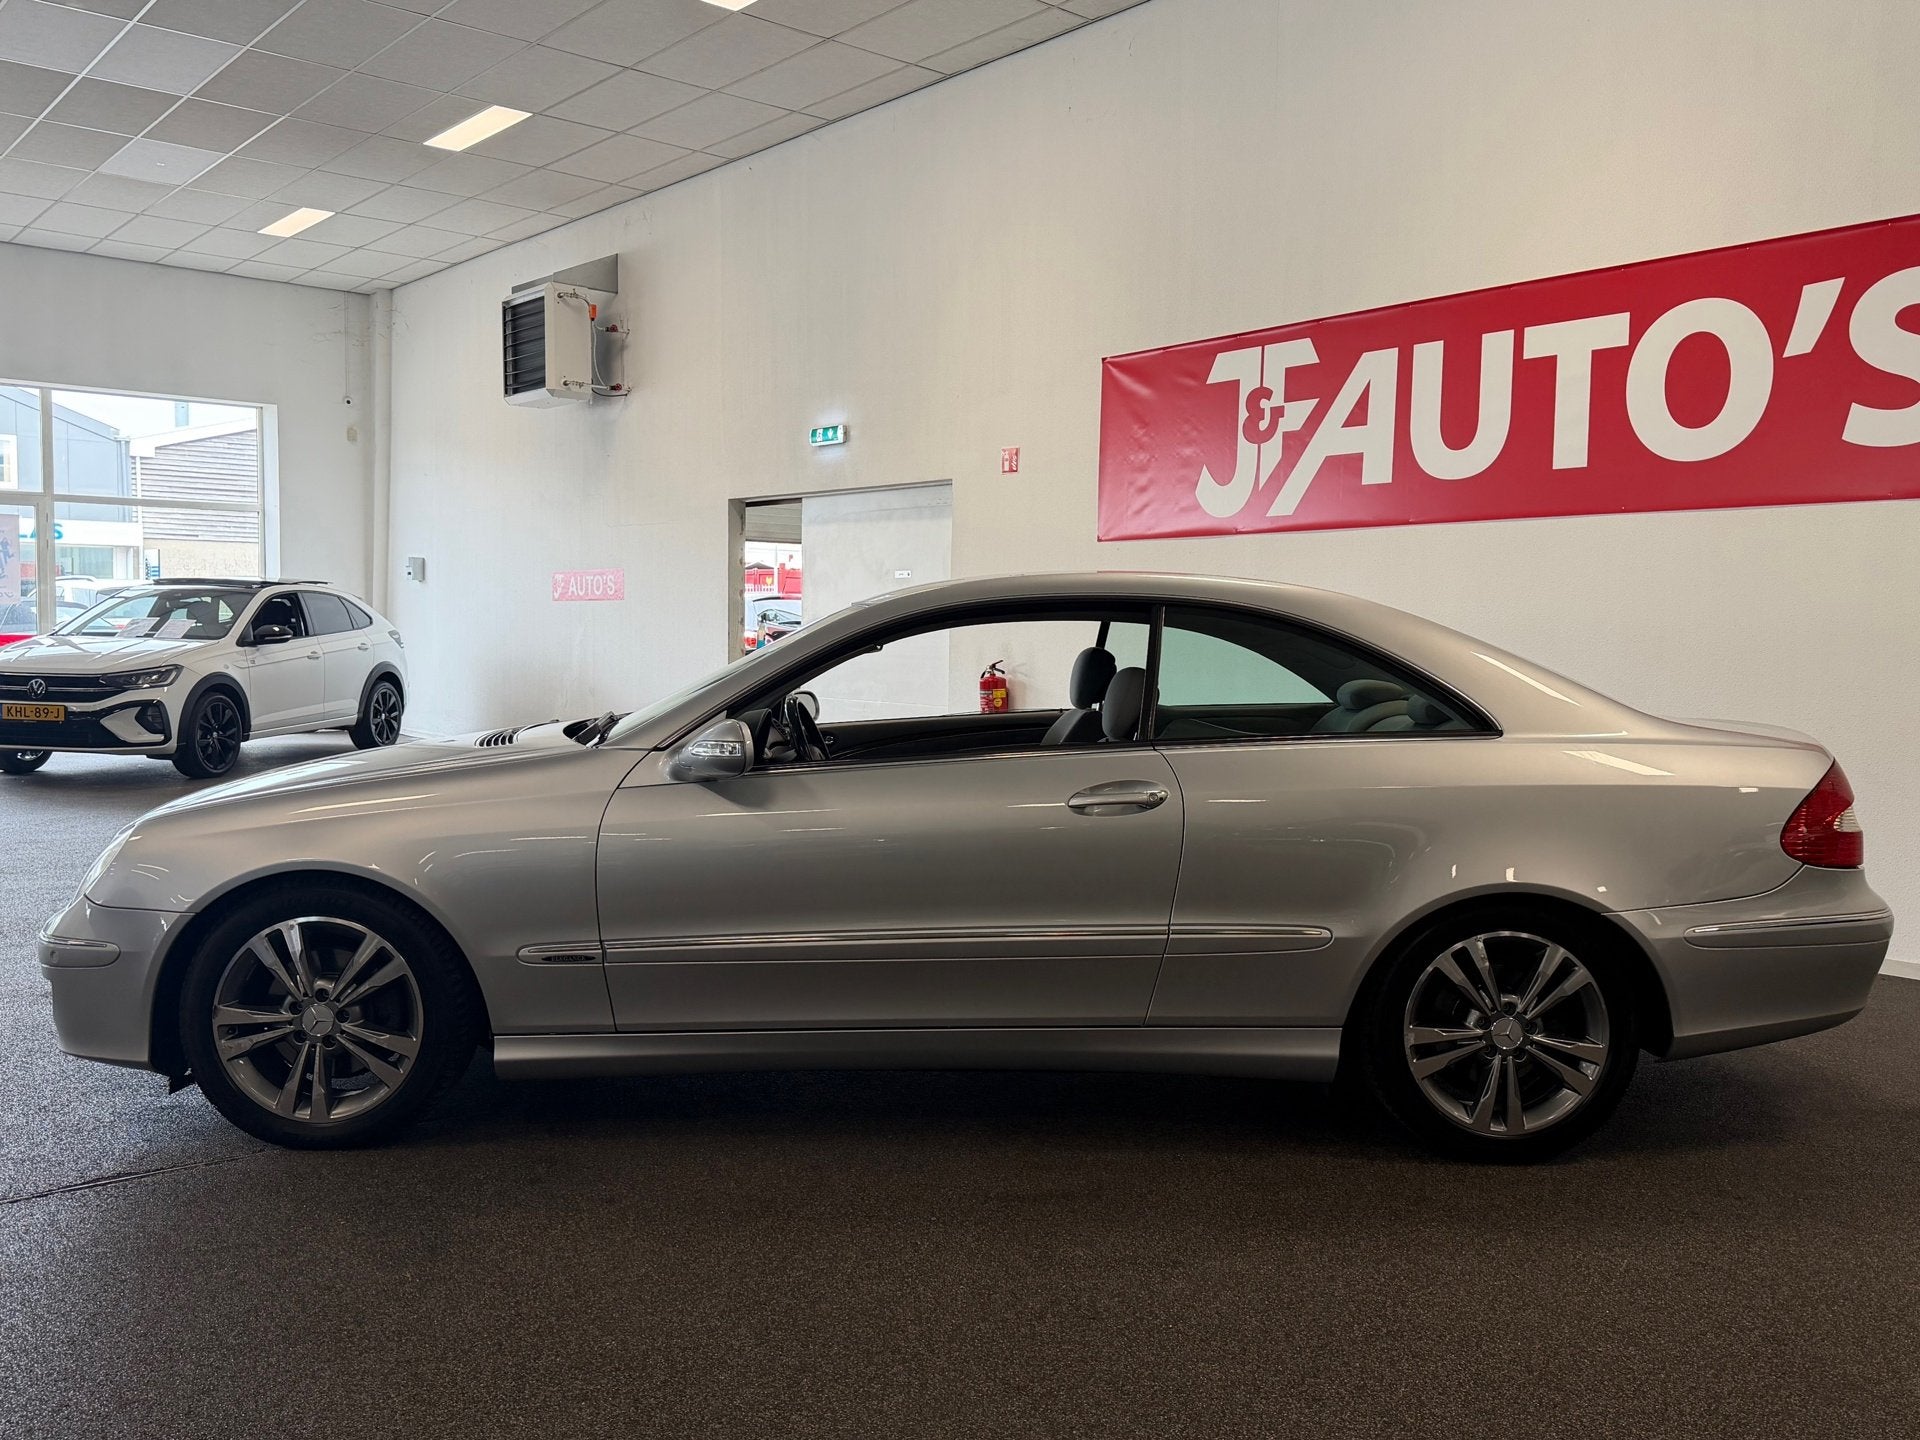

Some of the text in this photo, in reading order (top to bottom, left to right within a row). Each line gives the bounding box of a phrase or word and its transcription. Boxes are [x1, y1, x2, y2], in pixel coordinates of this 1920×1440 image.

[1265, 265, 1920, 517] AUTO'S
[568, 574, 616, 596] AUTO'S
[6, 705, 60, 719] KHL-89-J
